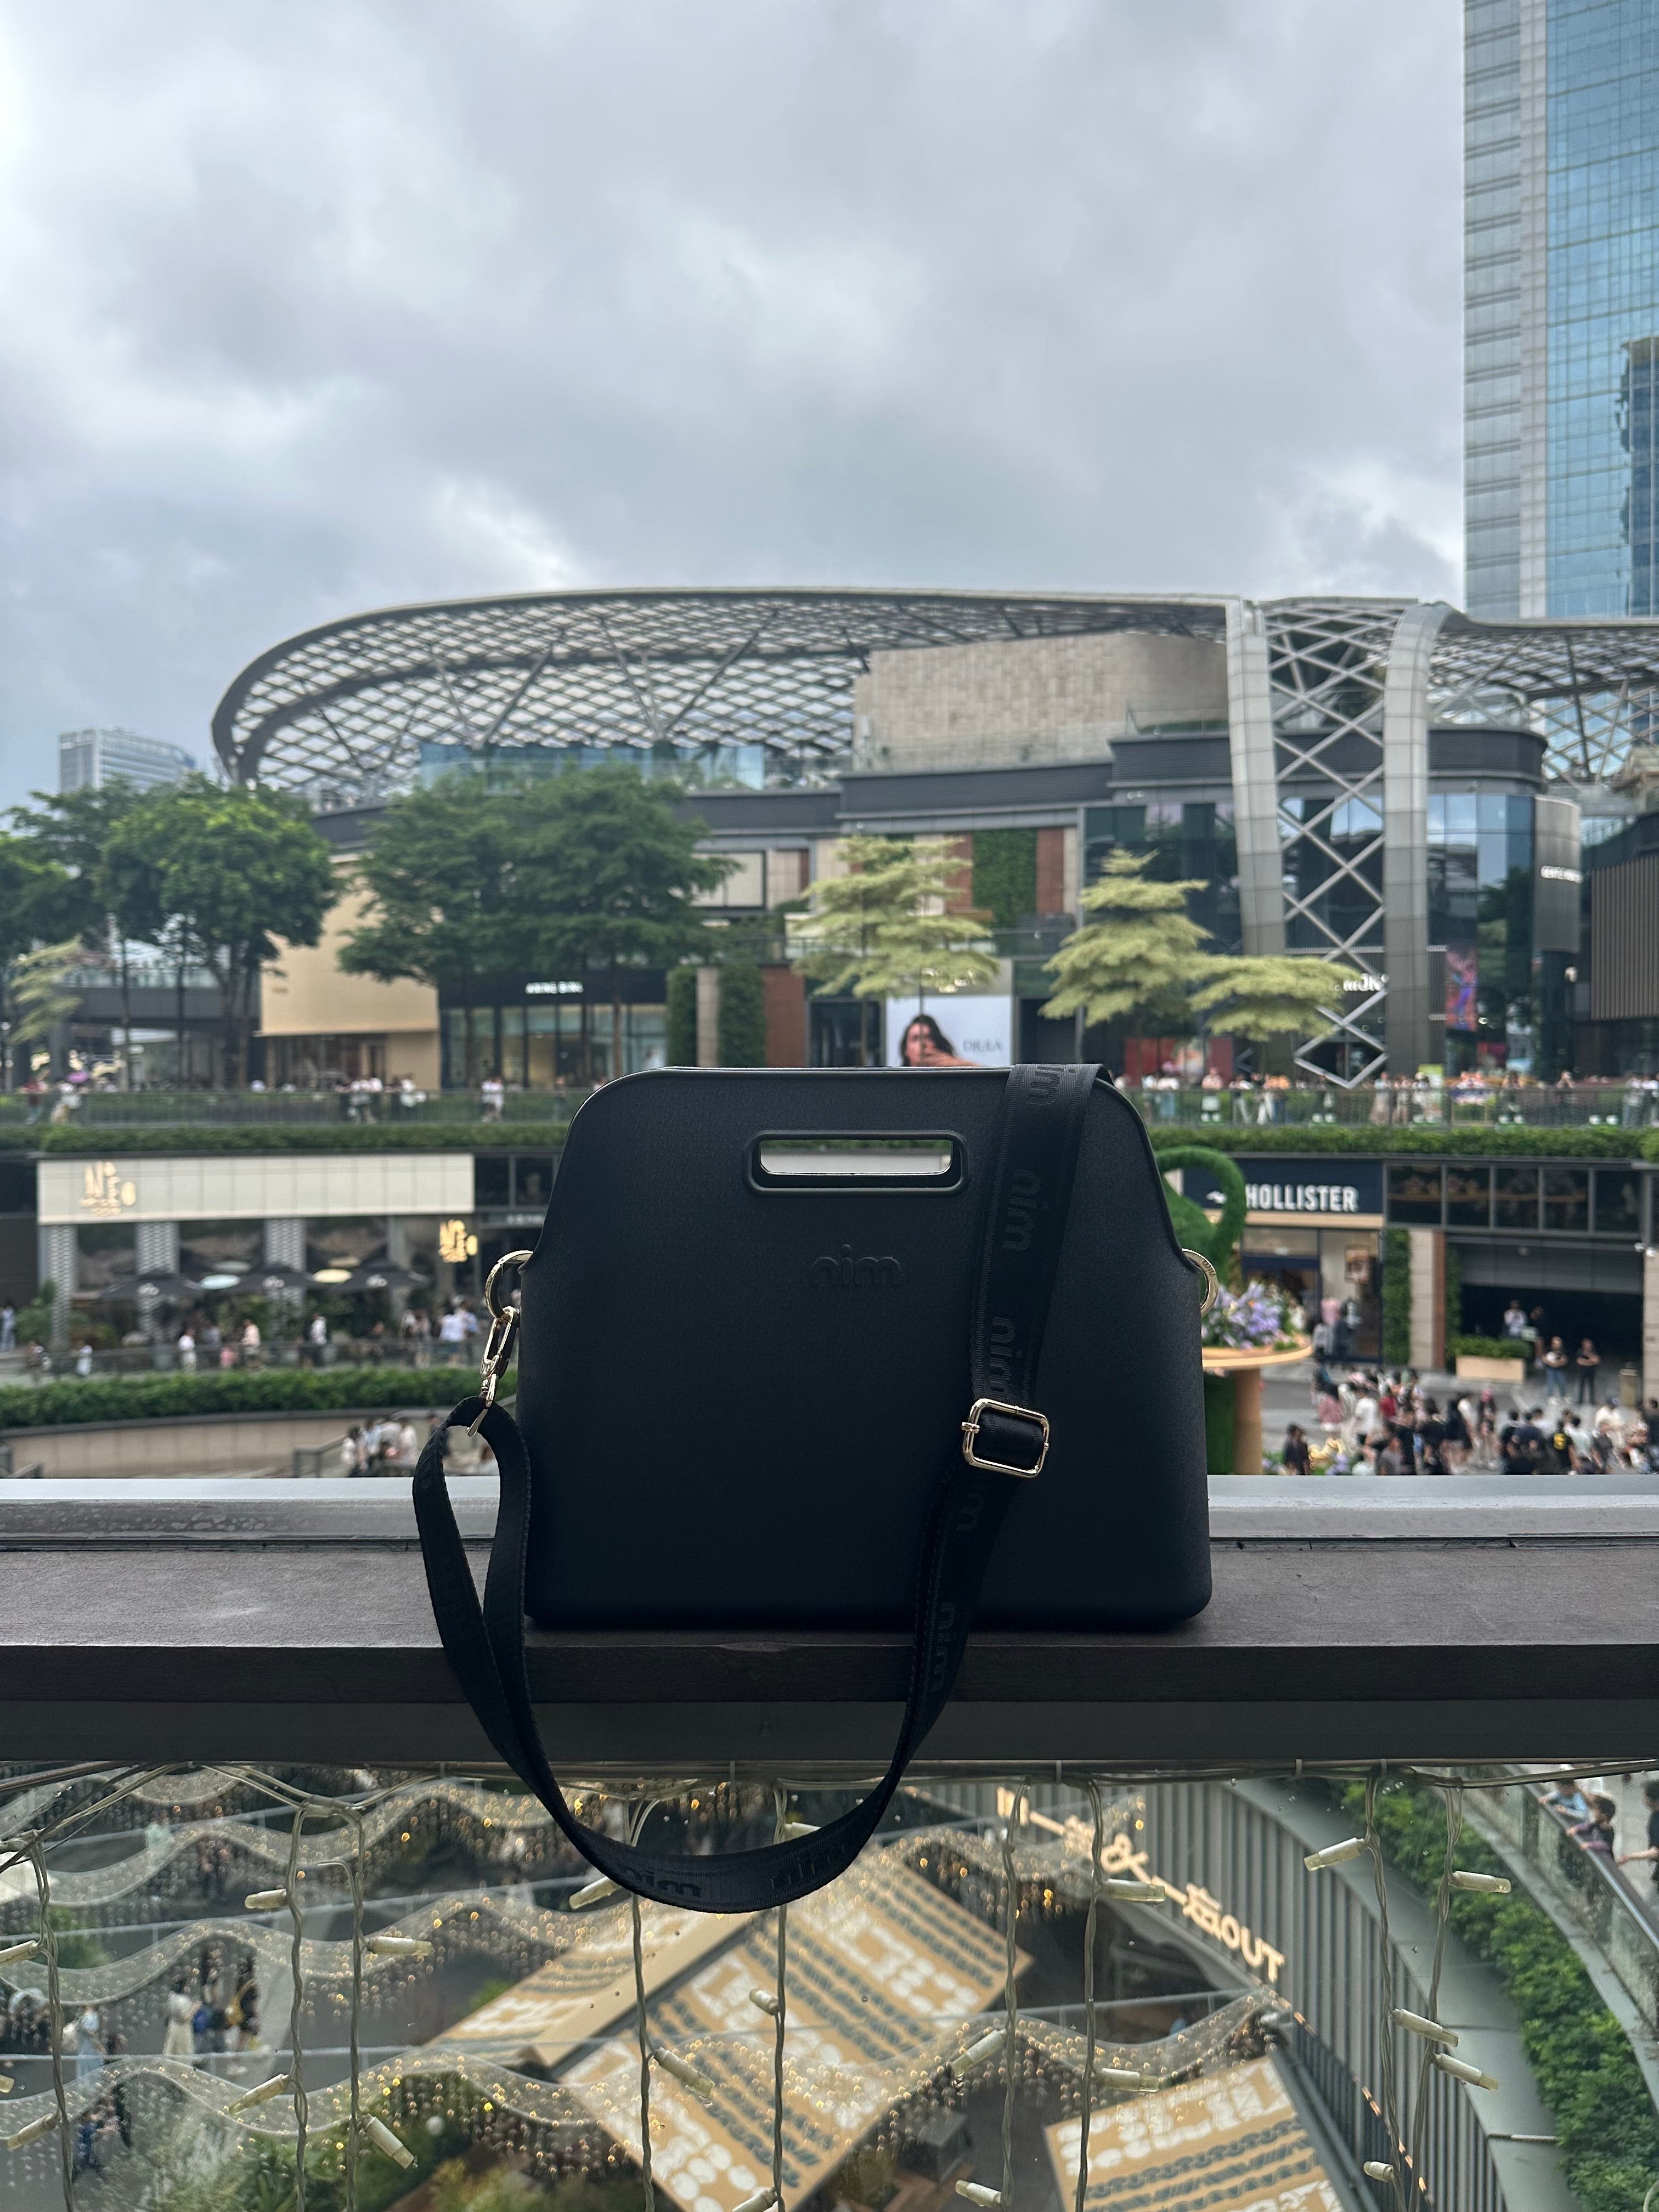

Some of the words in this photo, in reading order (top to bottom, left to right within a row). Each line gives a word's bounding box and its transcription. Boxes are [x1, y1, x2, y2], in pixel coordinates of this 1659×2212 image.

[1002, 1169, 1048, 1251] nim
[1245, 1183, 1359, 1212] HOLLISTER
[811, 1243, 901, 1286] nim
